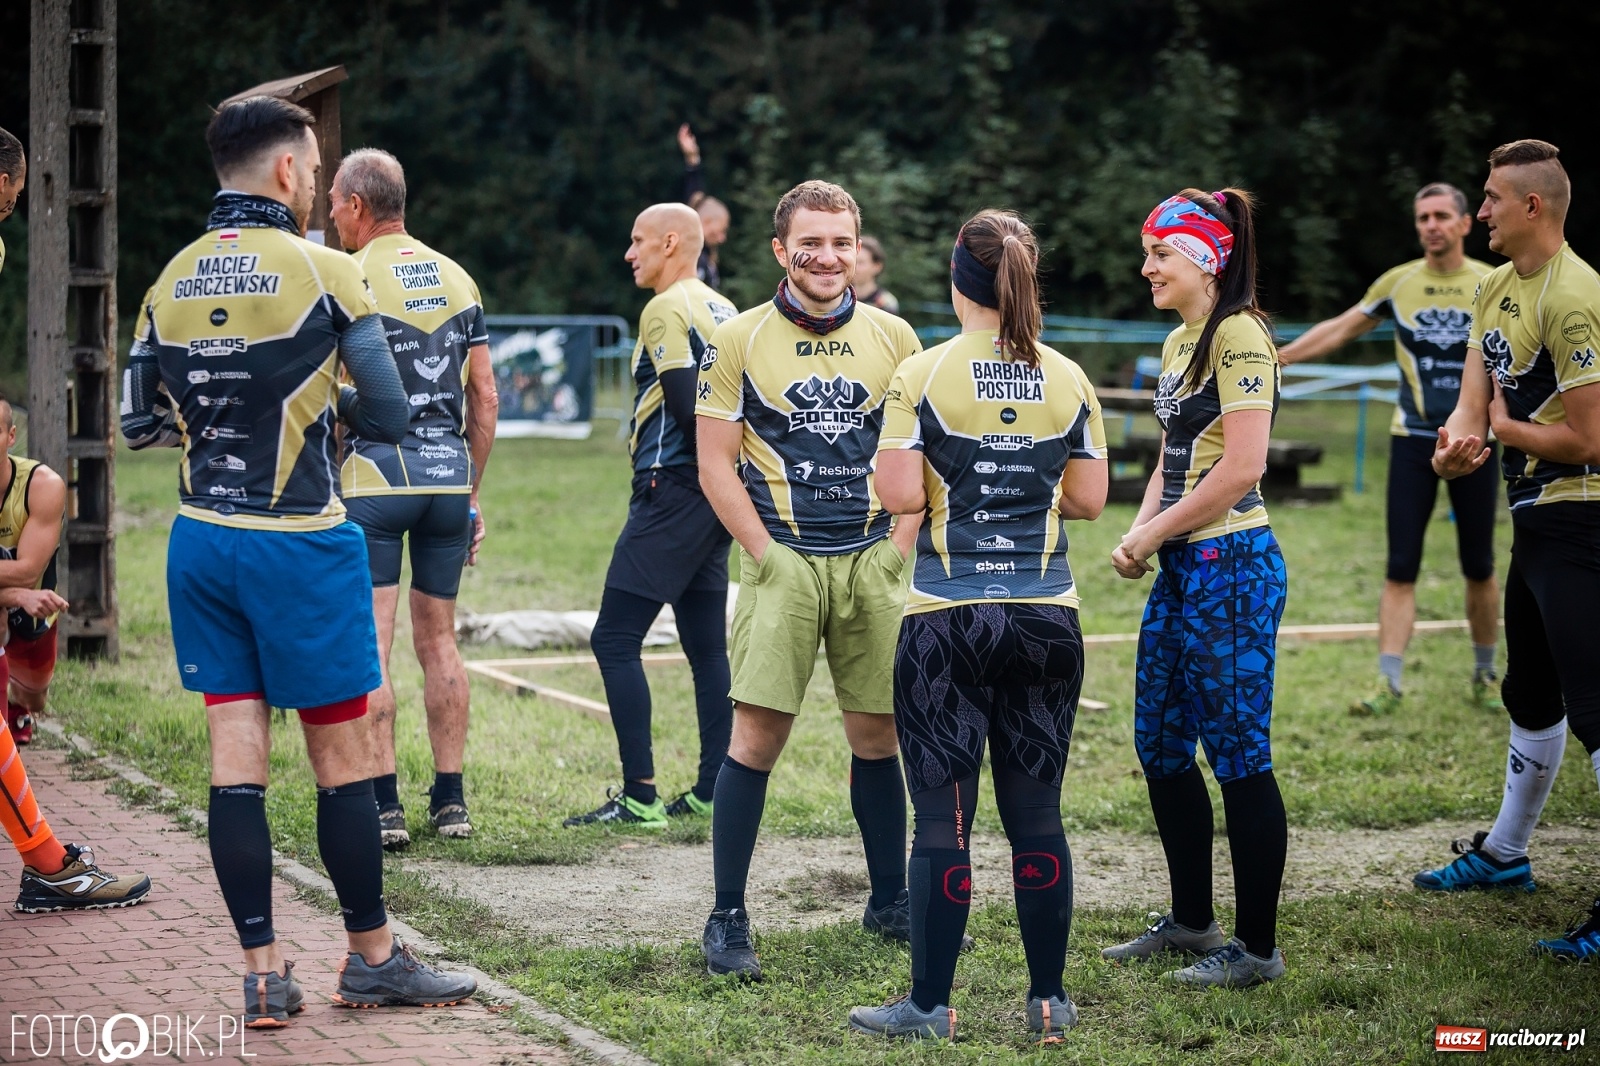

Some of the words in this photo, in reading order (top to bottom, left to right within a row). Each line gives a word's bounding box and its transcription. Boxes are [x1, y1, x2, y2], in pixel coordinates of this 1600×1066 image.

[1172, 239, 1198, 260] GLIWICKI
[197, 255, 257, 277] MACIEJ
[392, 261, 439, 277] ZYGMUNT
[174, 275, 280, 299] GORCZEWSKI
[402, 274, 441, 289] CHOJNA
[405, 297, 447, 311] SOCIOS
[190, 338, 245, 352] SOCIOS
[402, 341, 420, 352] APA
[813, 341, 855, 357] APA
[972, 362, 1044, 381] BARBARA
[977, 381, 1042, 401] POSTUŁA
[790, 411, 864, 431] SOCIOS
[982, 434, 1033, 447] SOCIOS
[819, 465, 867, 478] ReShape
